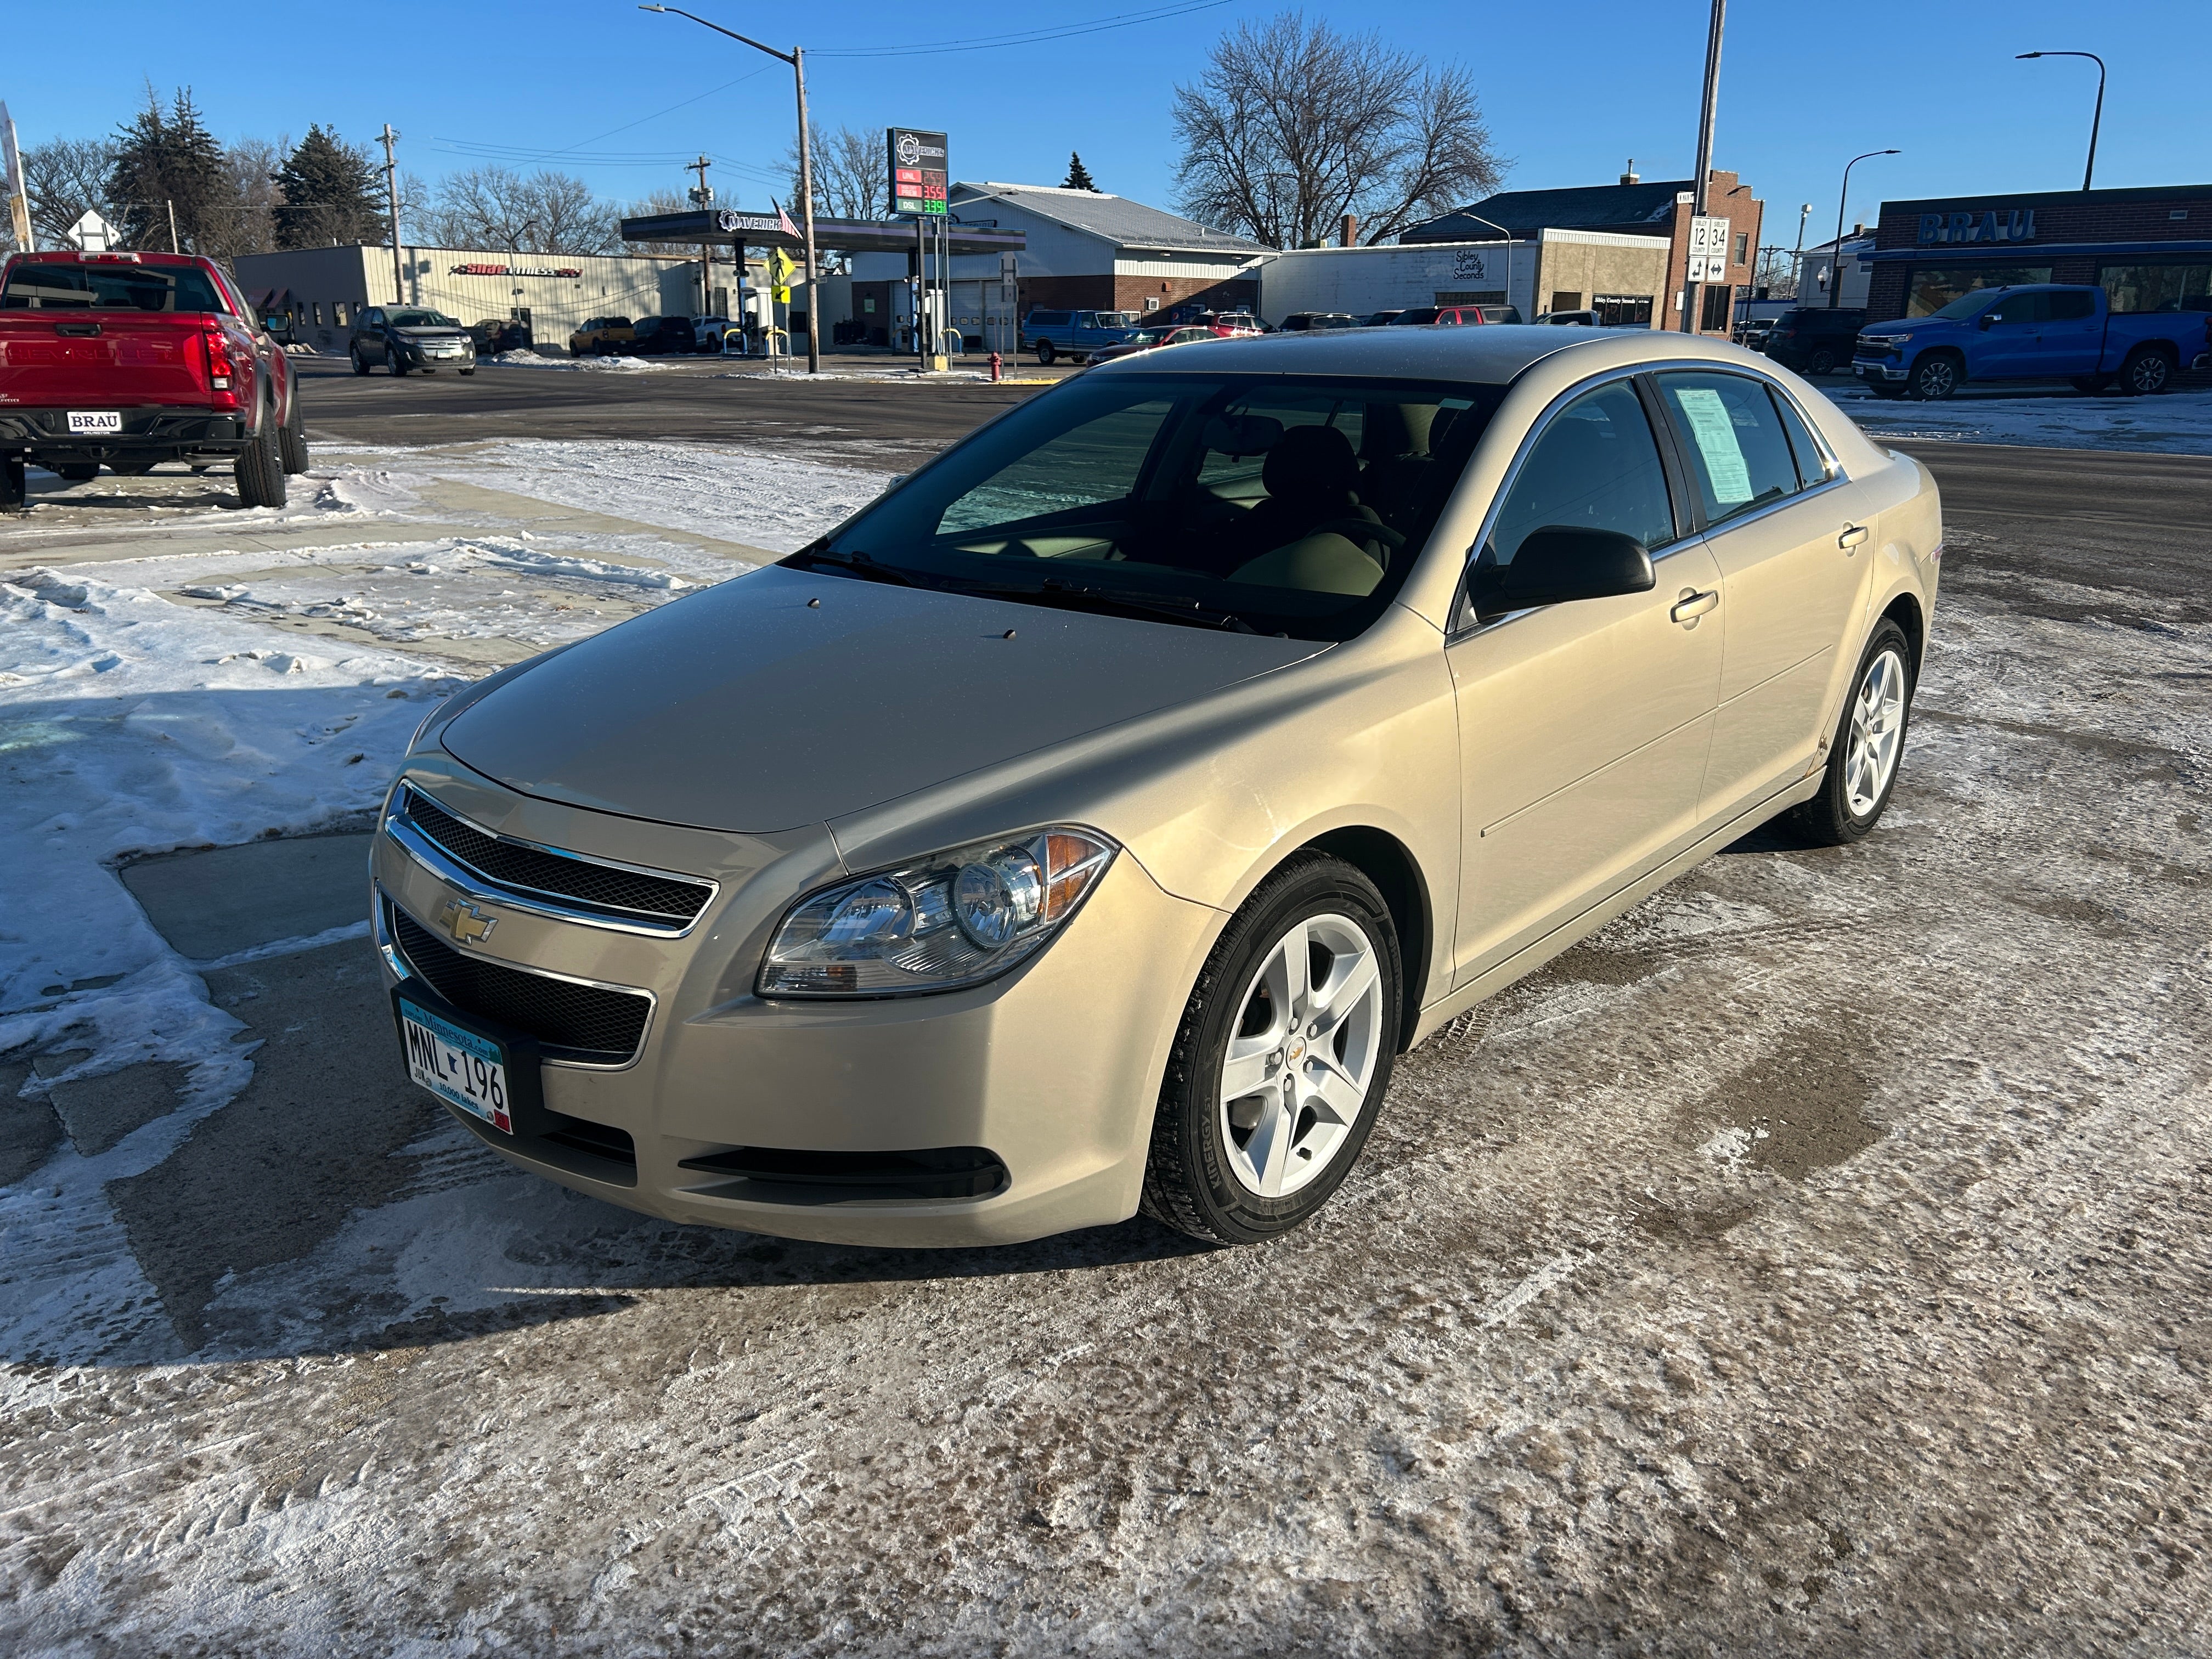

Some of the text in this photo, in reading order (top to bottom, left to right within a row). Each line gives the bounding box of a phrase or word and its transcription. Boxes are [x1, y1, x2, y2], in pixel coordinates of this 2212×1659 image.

[902, 172, 916, 180] UNL
[902, 201, 916, 210] DSL
[1917, 210, 2034, 244] BRAU
[1695, 228, 1705, 245] 12
[1712, 229, 1725, 246] 34
[1456, 250, 1479, 263] Sibley
[1454, 268, 1484, 279] Seconds
[1460, 259, 1484, 273] County
[0, 348, 174, 360] HEVROLET
[70, 415, 117, 427] BRAU
[424, 1012, 488, 1056] Minnesota.com
[407, 1020, 504, 1110] MNL 196
[414, 1066, 426, 1082] JUN
[439, 1082, 479, 1110] 10,000 lakes
